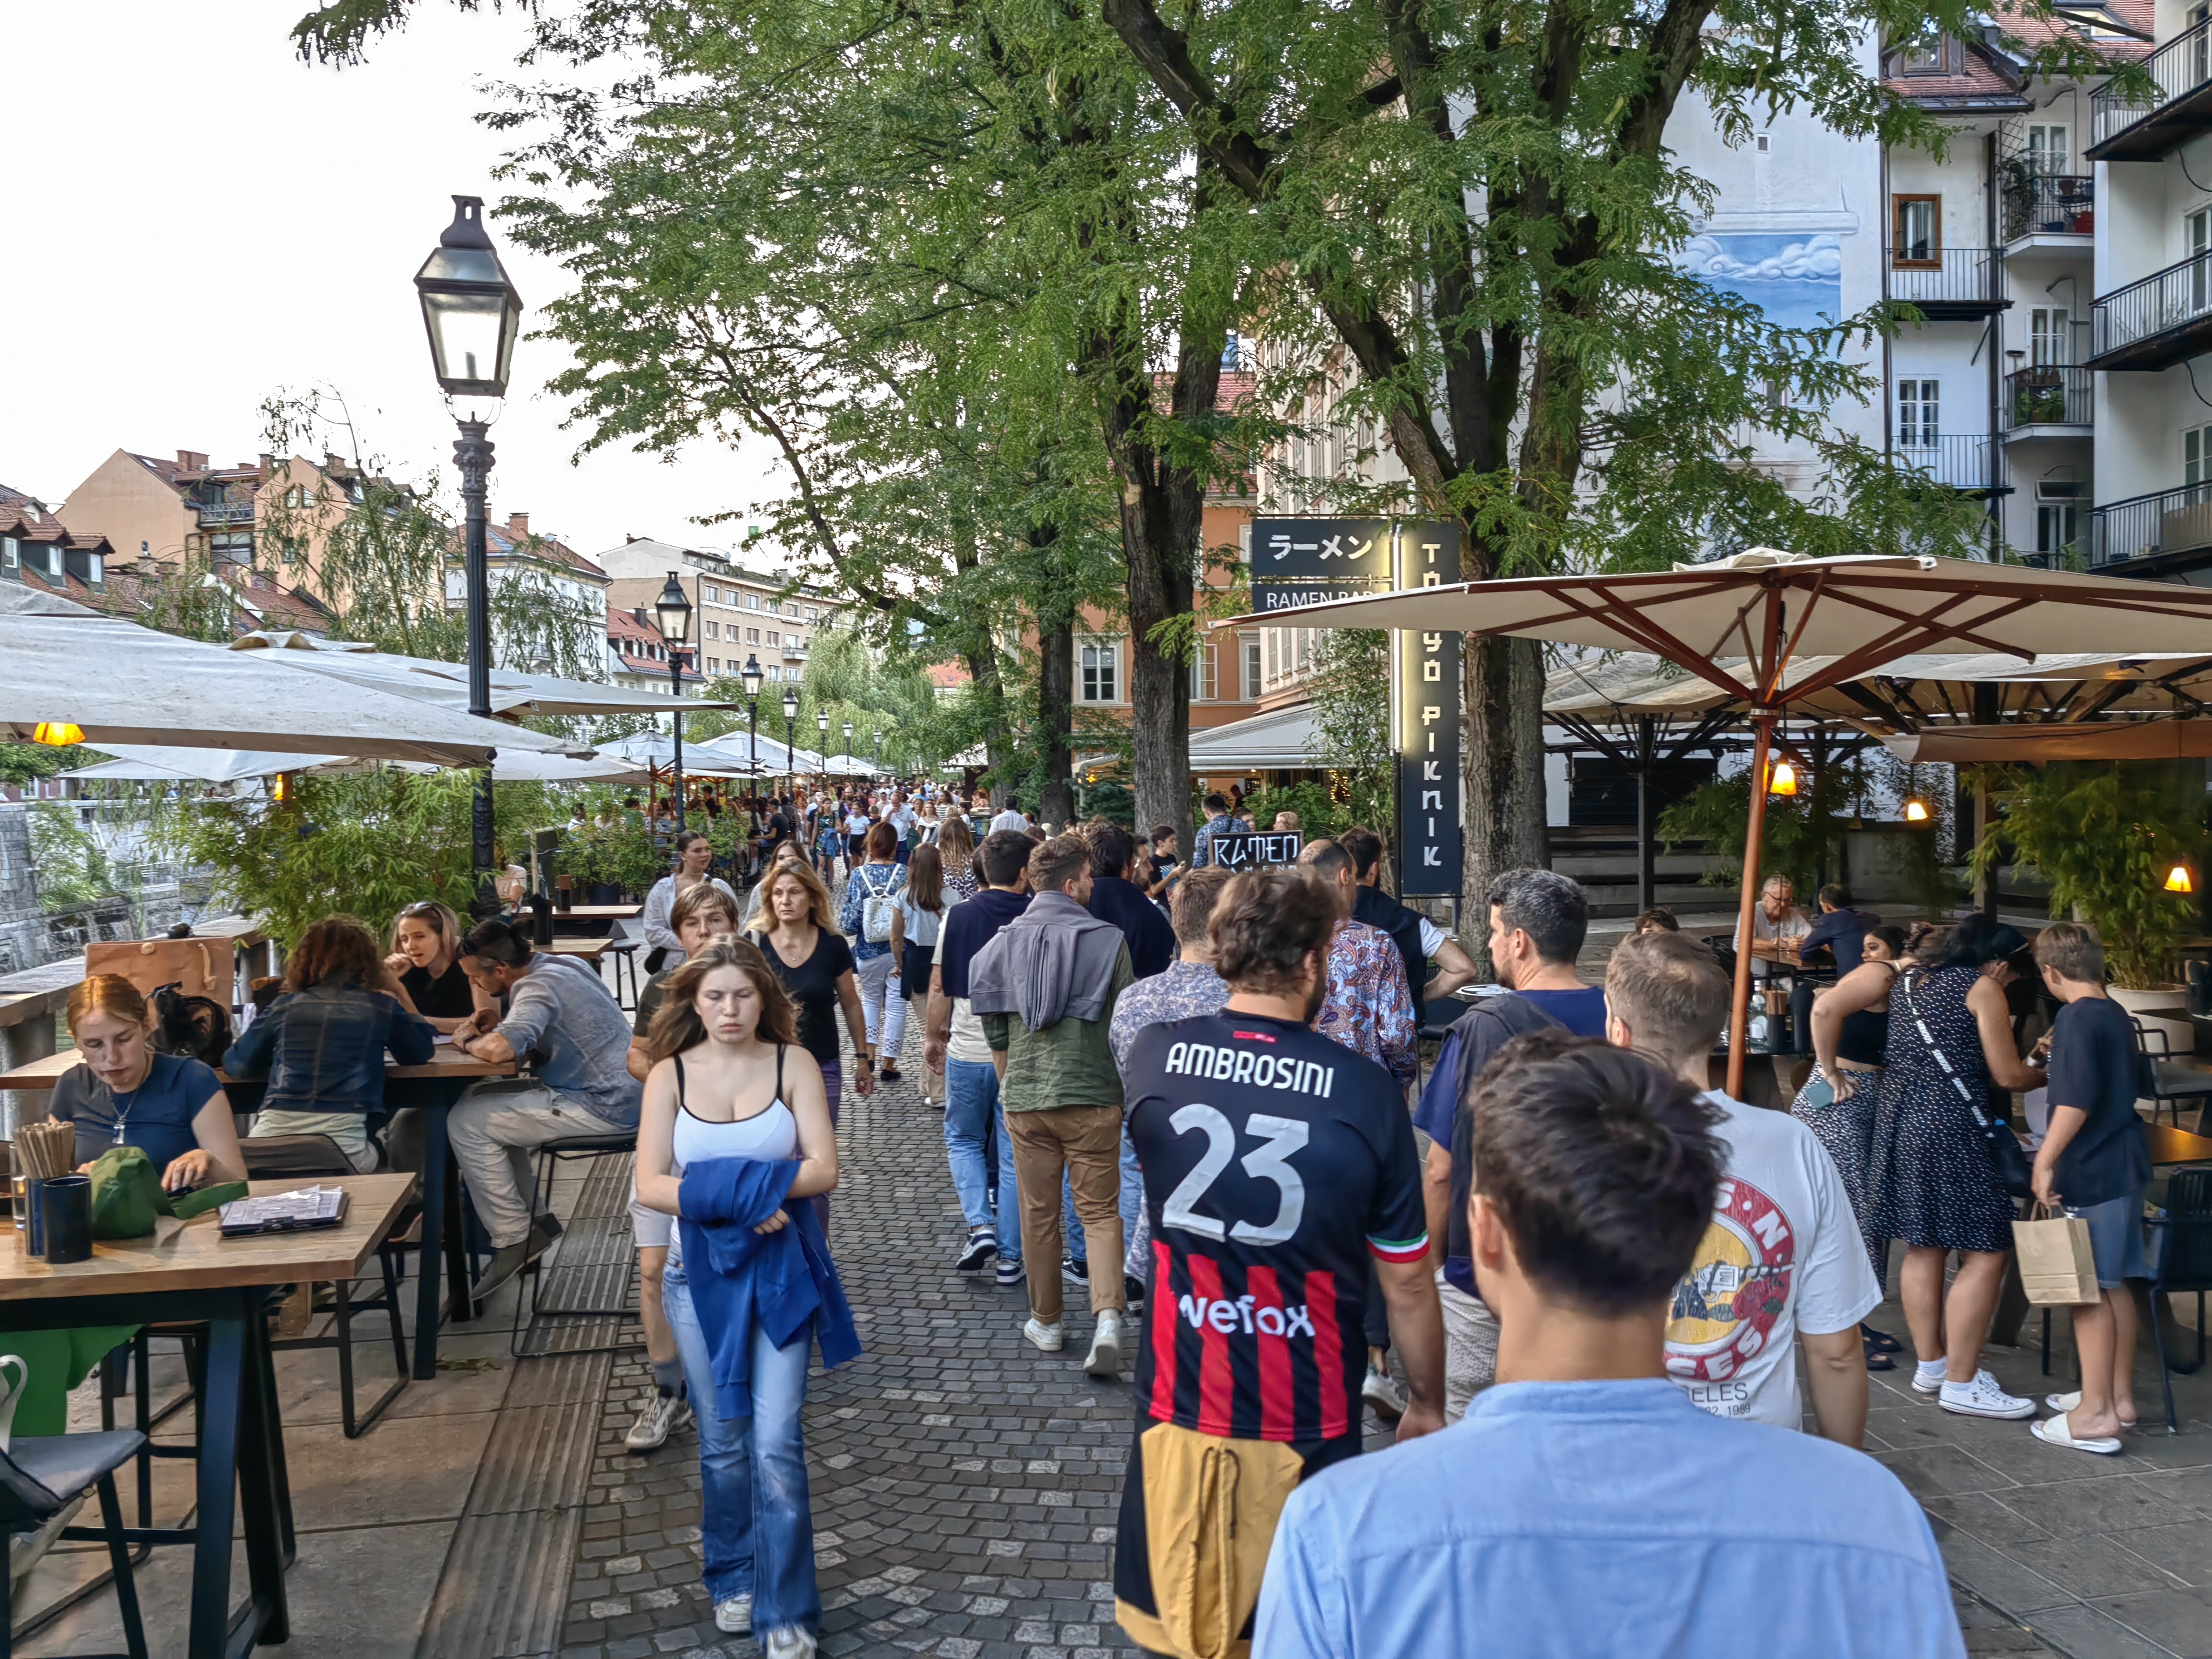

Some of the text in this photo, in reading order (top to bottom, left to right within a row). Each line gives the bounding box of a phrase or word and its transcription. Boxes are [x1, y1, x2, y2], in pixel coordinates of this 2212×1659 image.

[1269, 535, 1373, 561] ラーメン
[1266, 591, 1332, 609] RAMEN
[1421, 543, 1443, 682] TOYO
[1165, 1041, 1334, 1098] AMBROSINI
[1162, 1103, 1310, 1246] 23
[1179, 1294, 1316, 1338] wefox
